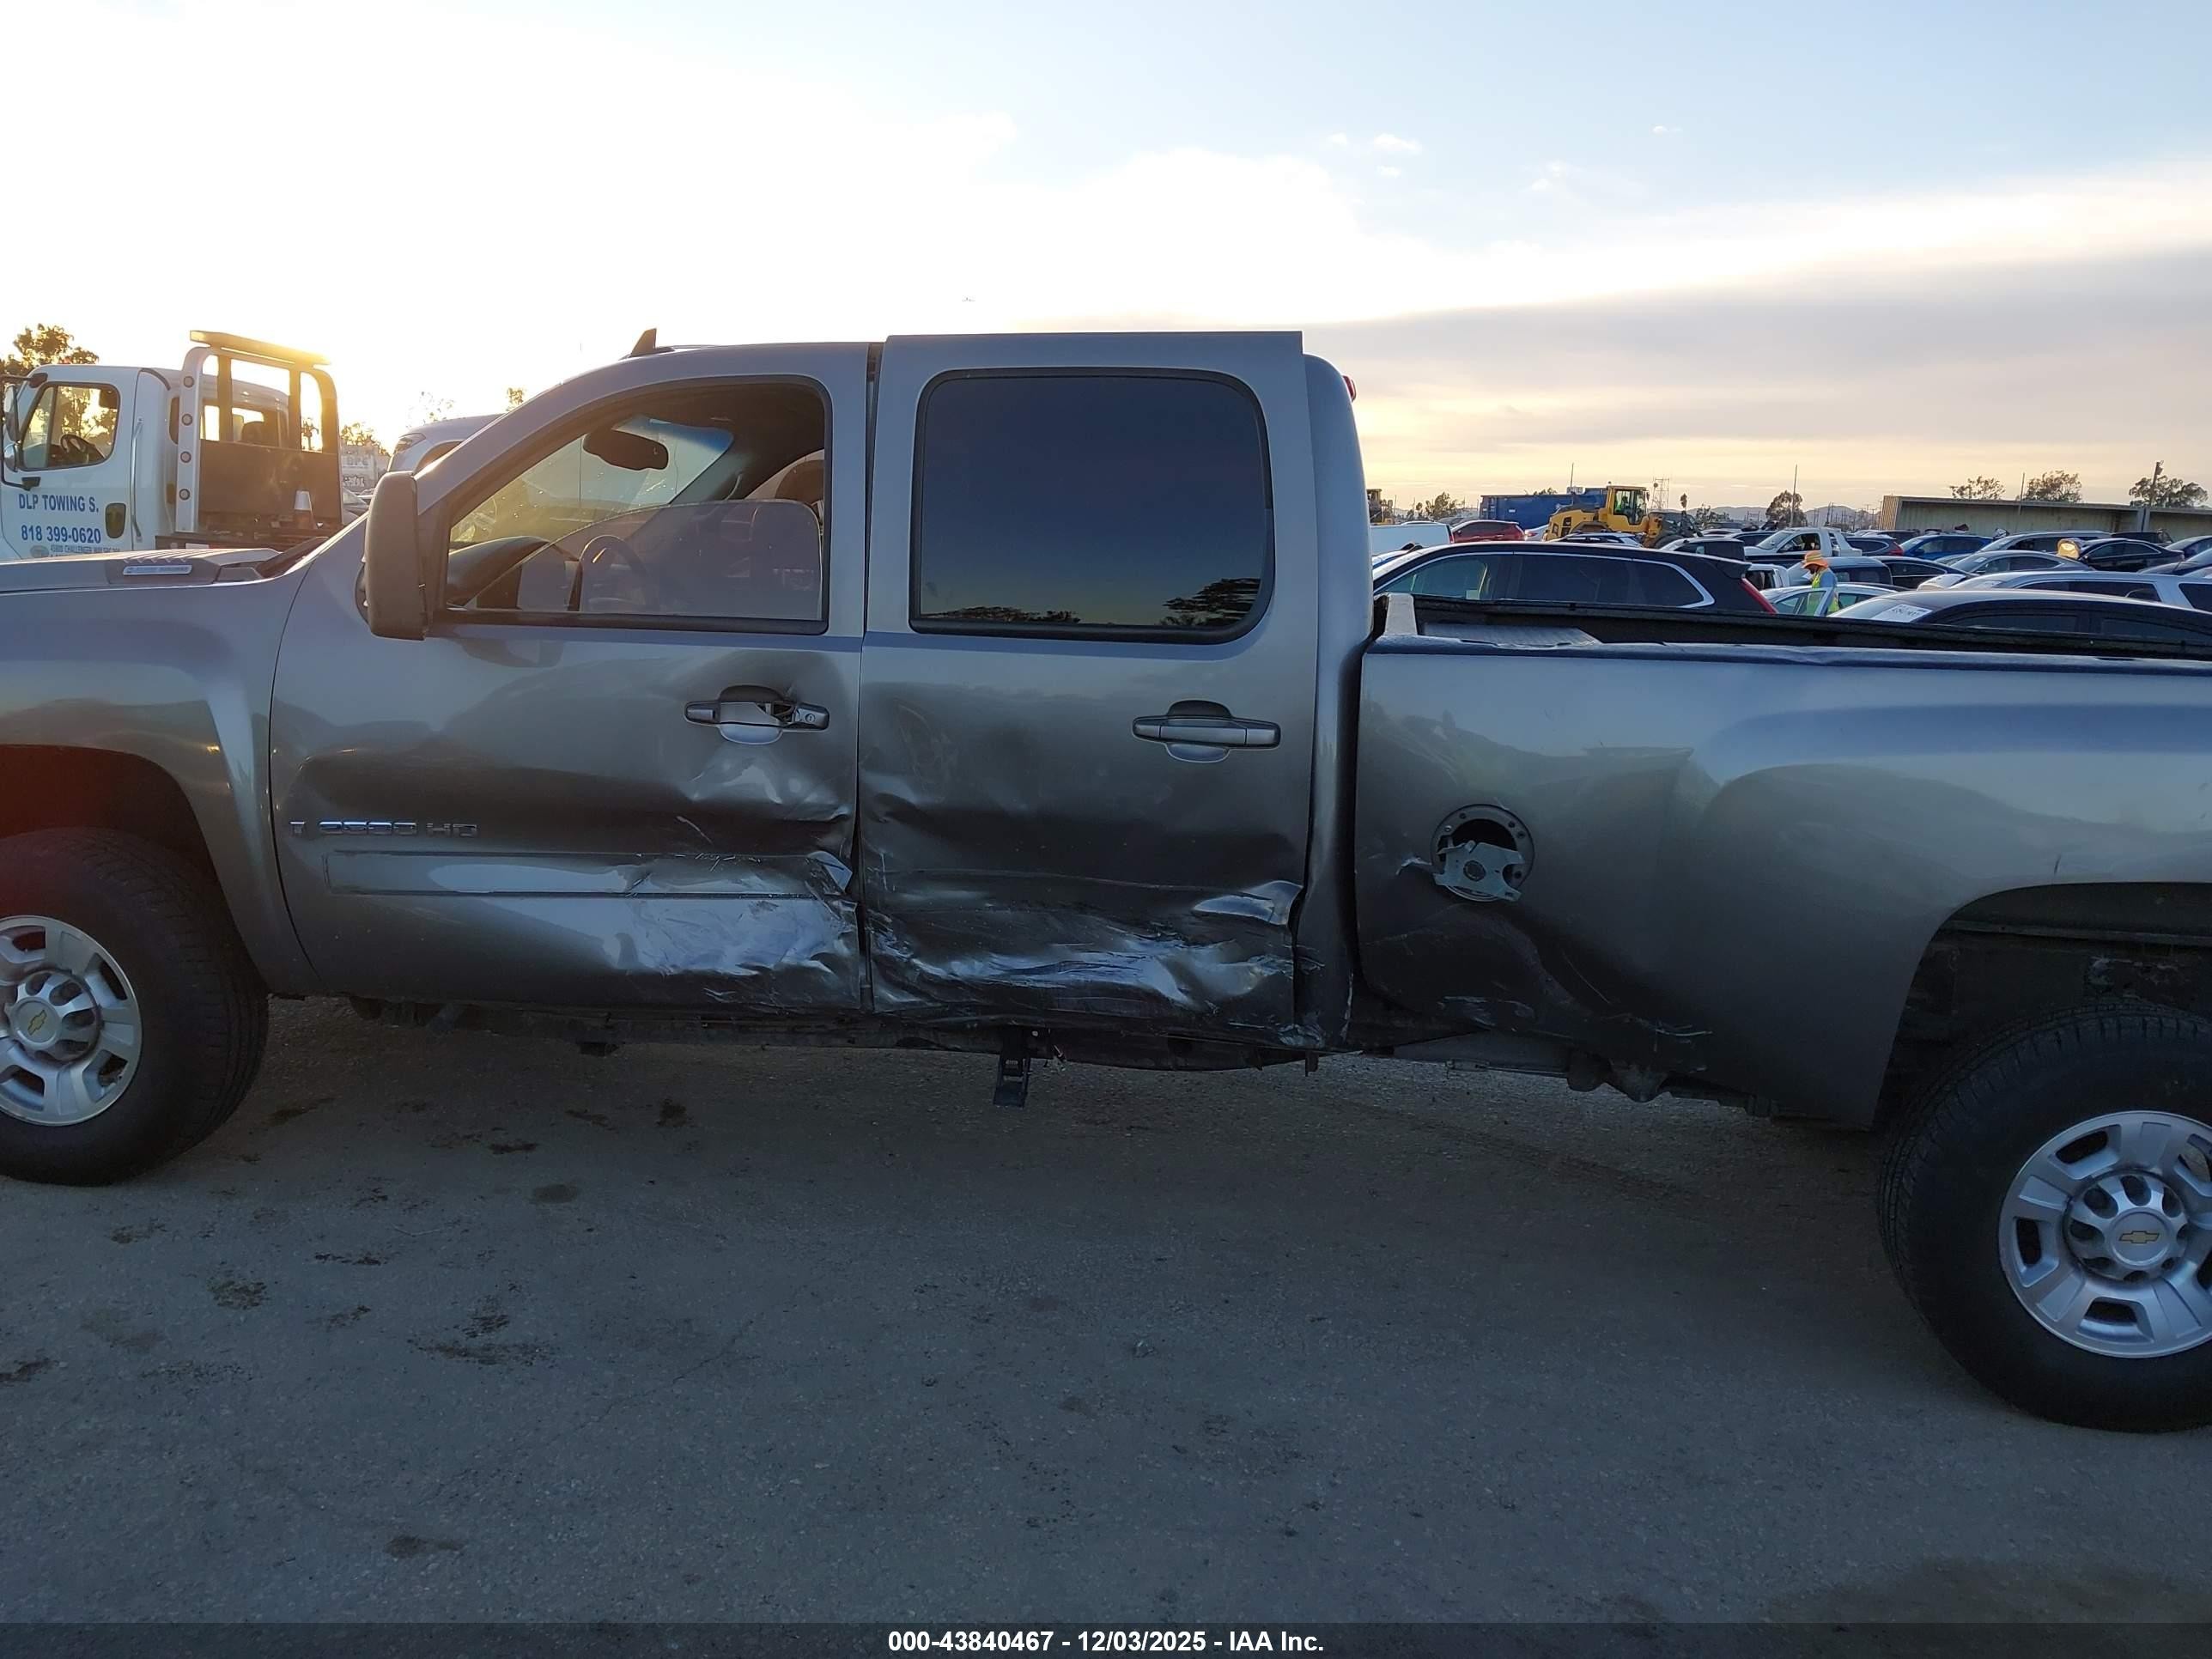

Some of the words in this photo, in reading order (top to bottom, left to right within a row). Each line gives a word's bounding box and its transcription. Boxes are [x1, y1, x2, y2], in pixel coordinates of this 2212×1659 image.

[18, 494, 39, 509] DLP
[42, 495, 85, 512] TOWING
[88, 496, 99, 513] S.
[21, 525, 42, 541] 818
[46, 526, 101, 544] 399-0620
